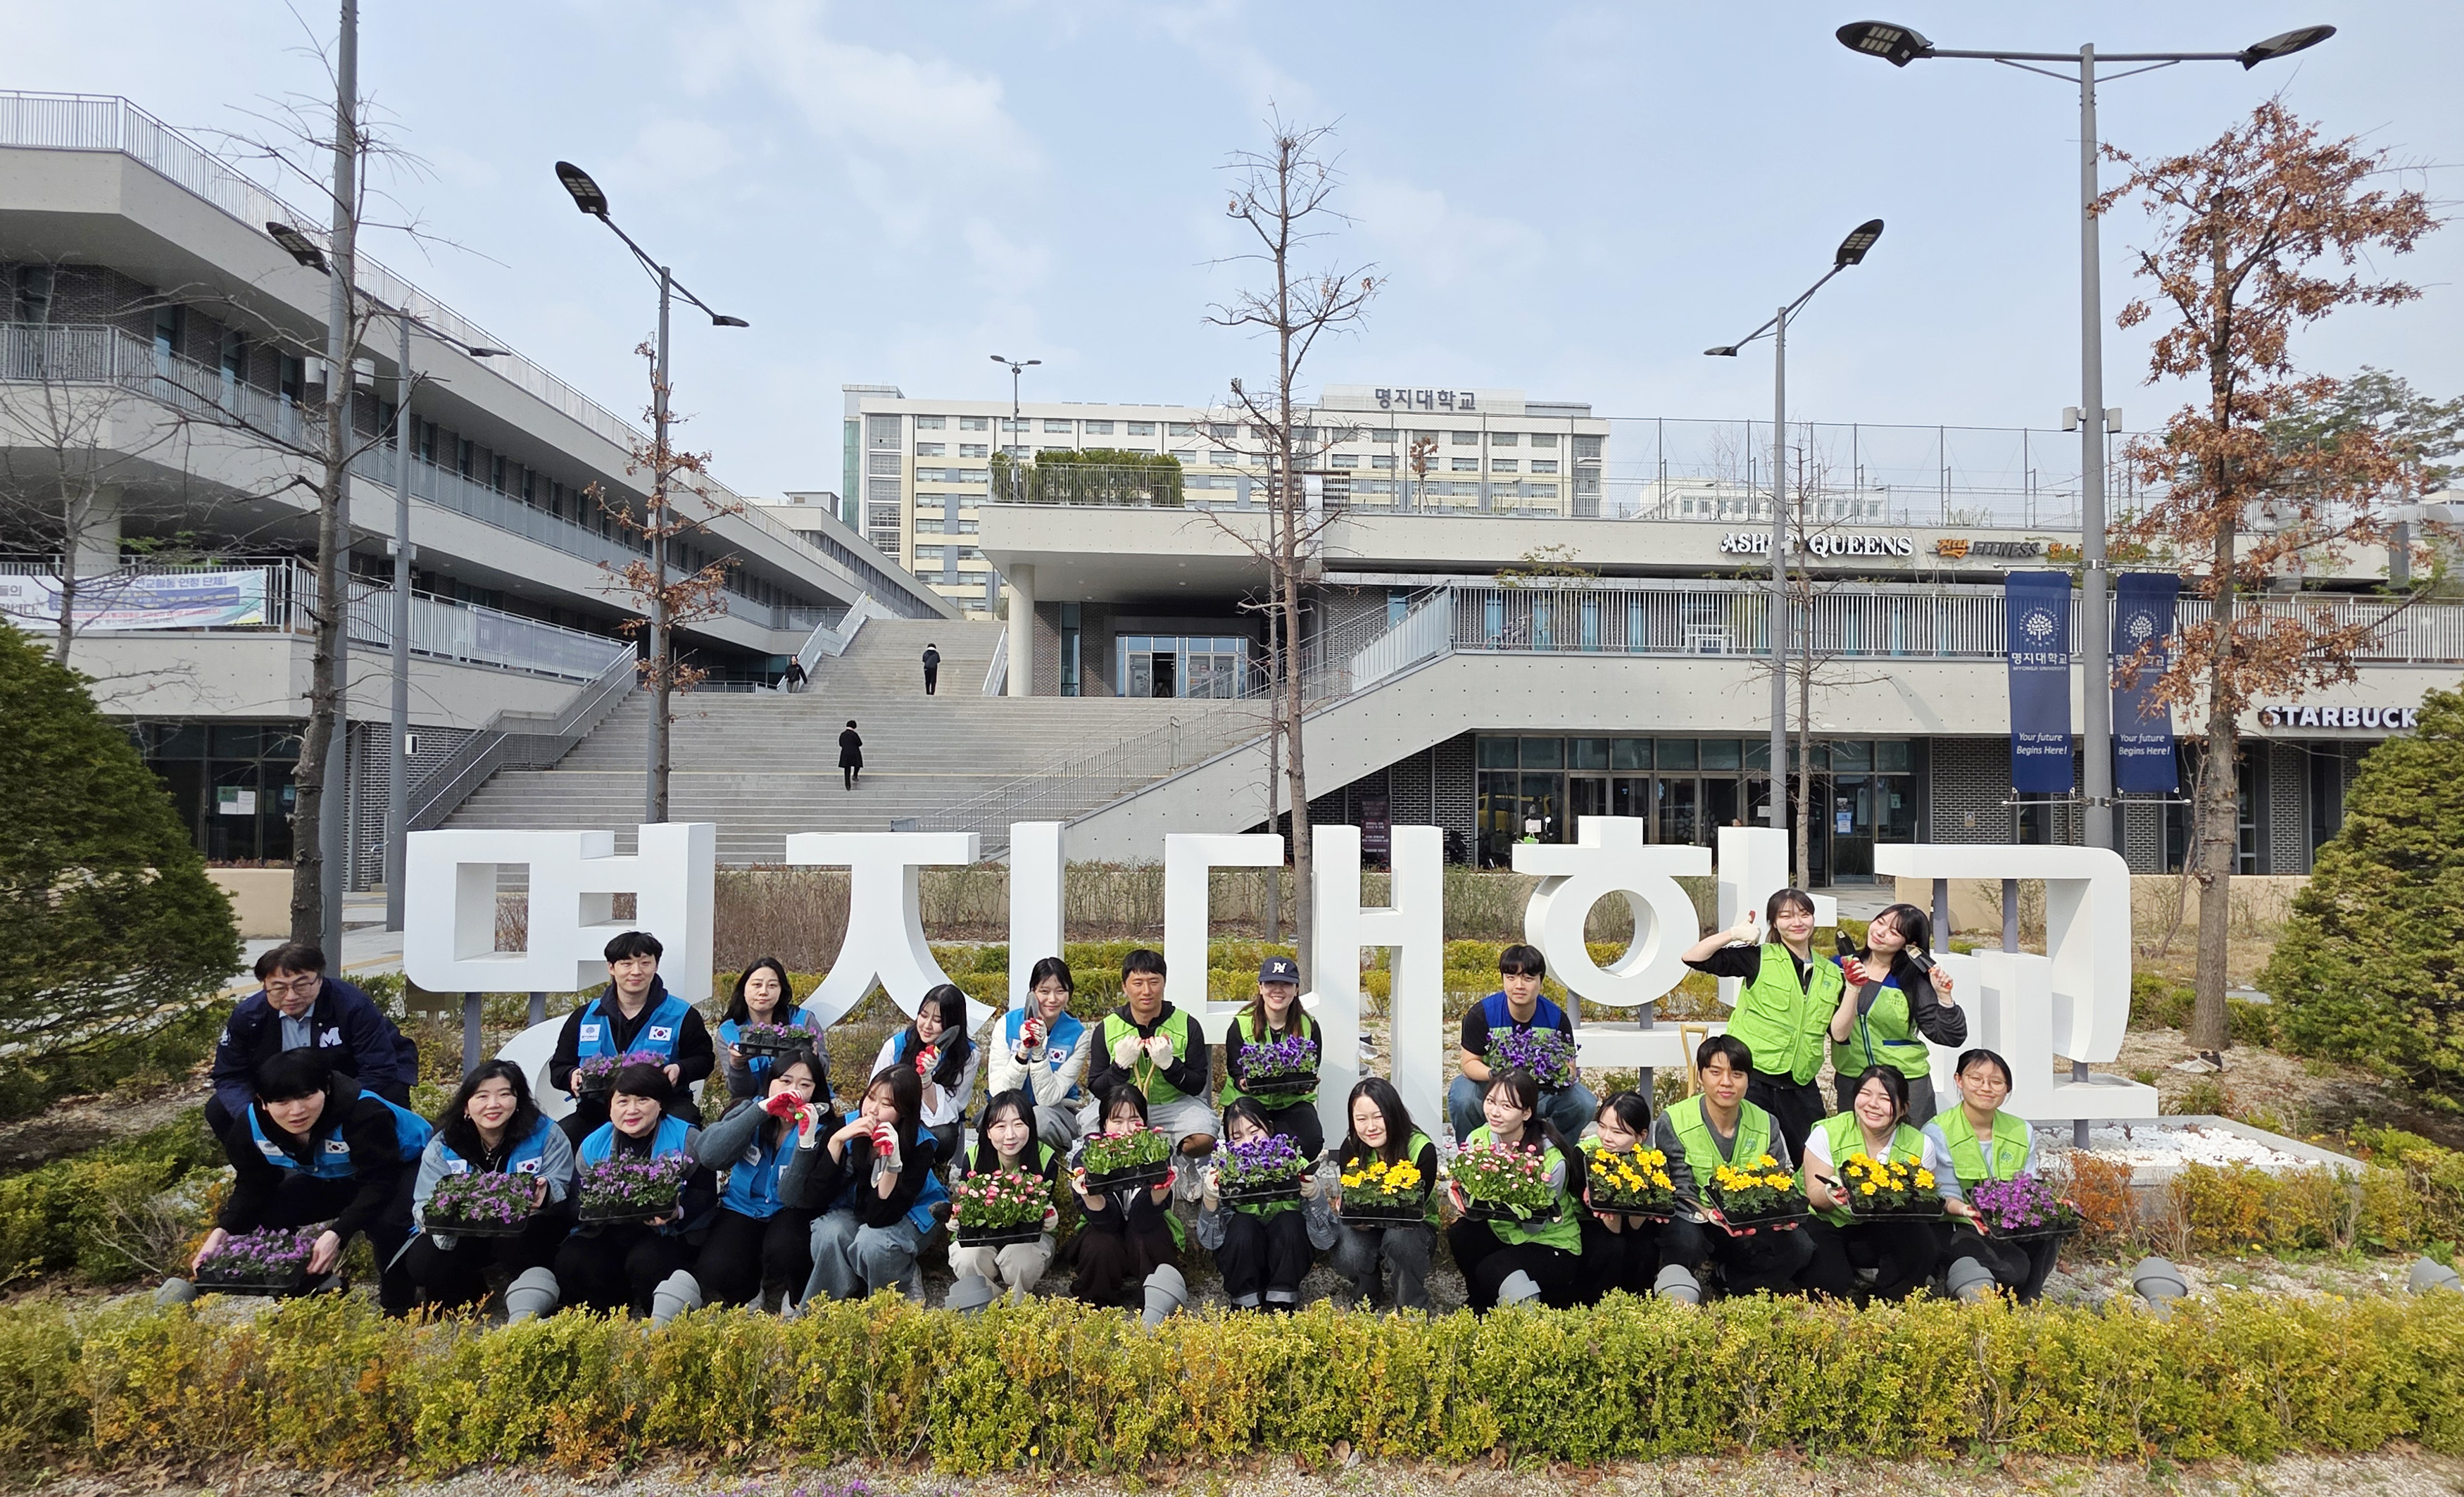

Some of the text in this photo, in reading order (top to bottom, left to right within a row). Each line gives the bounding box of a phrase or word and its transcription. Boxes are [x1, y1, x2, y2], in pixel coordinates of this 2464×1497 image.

[1375, 389, 1476, 411] 명지대학교
[1809, 534, 1913, 558] QUEENS
[1971, 541, 2041, 558] FITNESS
[2011, 652, 2068, 665] 명지대학교
[2018, 732, 2063, 743] Your future
[2120, 733, 2166, 744] Your future
[2016, 746, 2068, 756] Begins Here!
[2118, 746, 2170, 756] Begins Here!
[403, 815, 2158, 1152] 명지대학교
[319, 1027, 343, 1048] M
